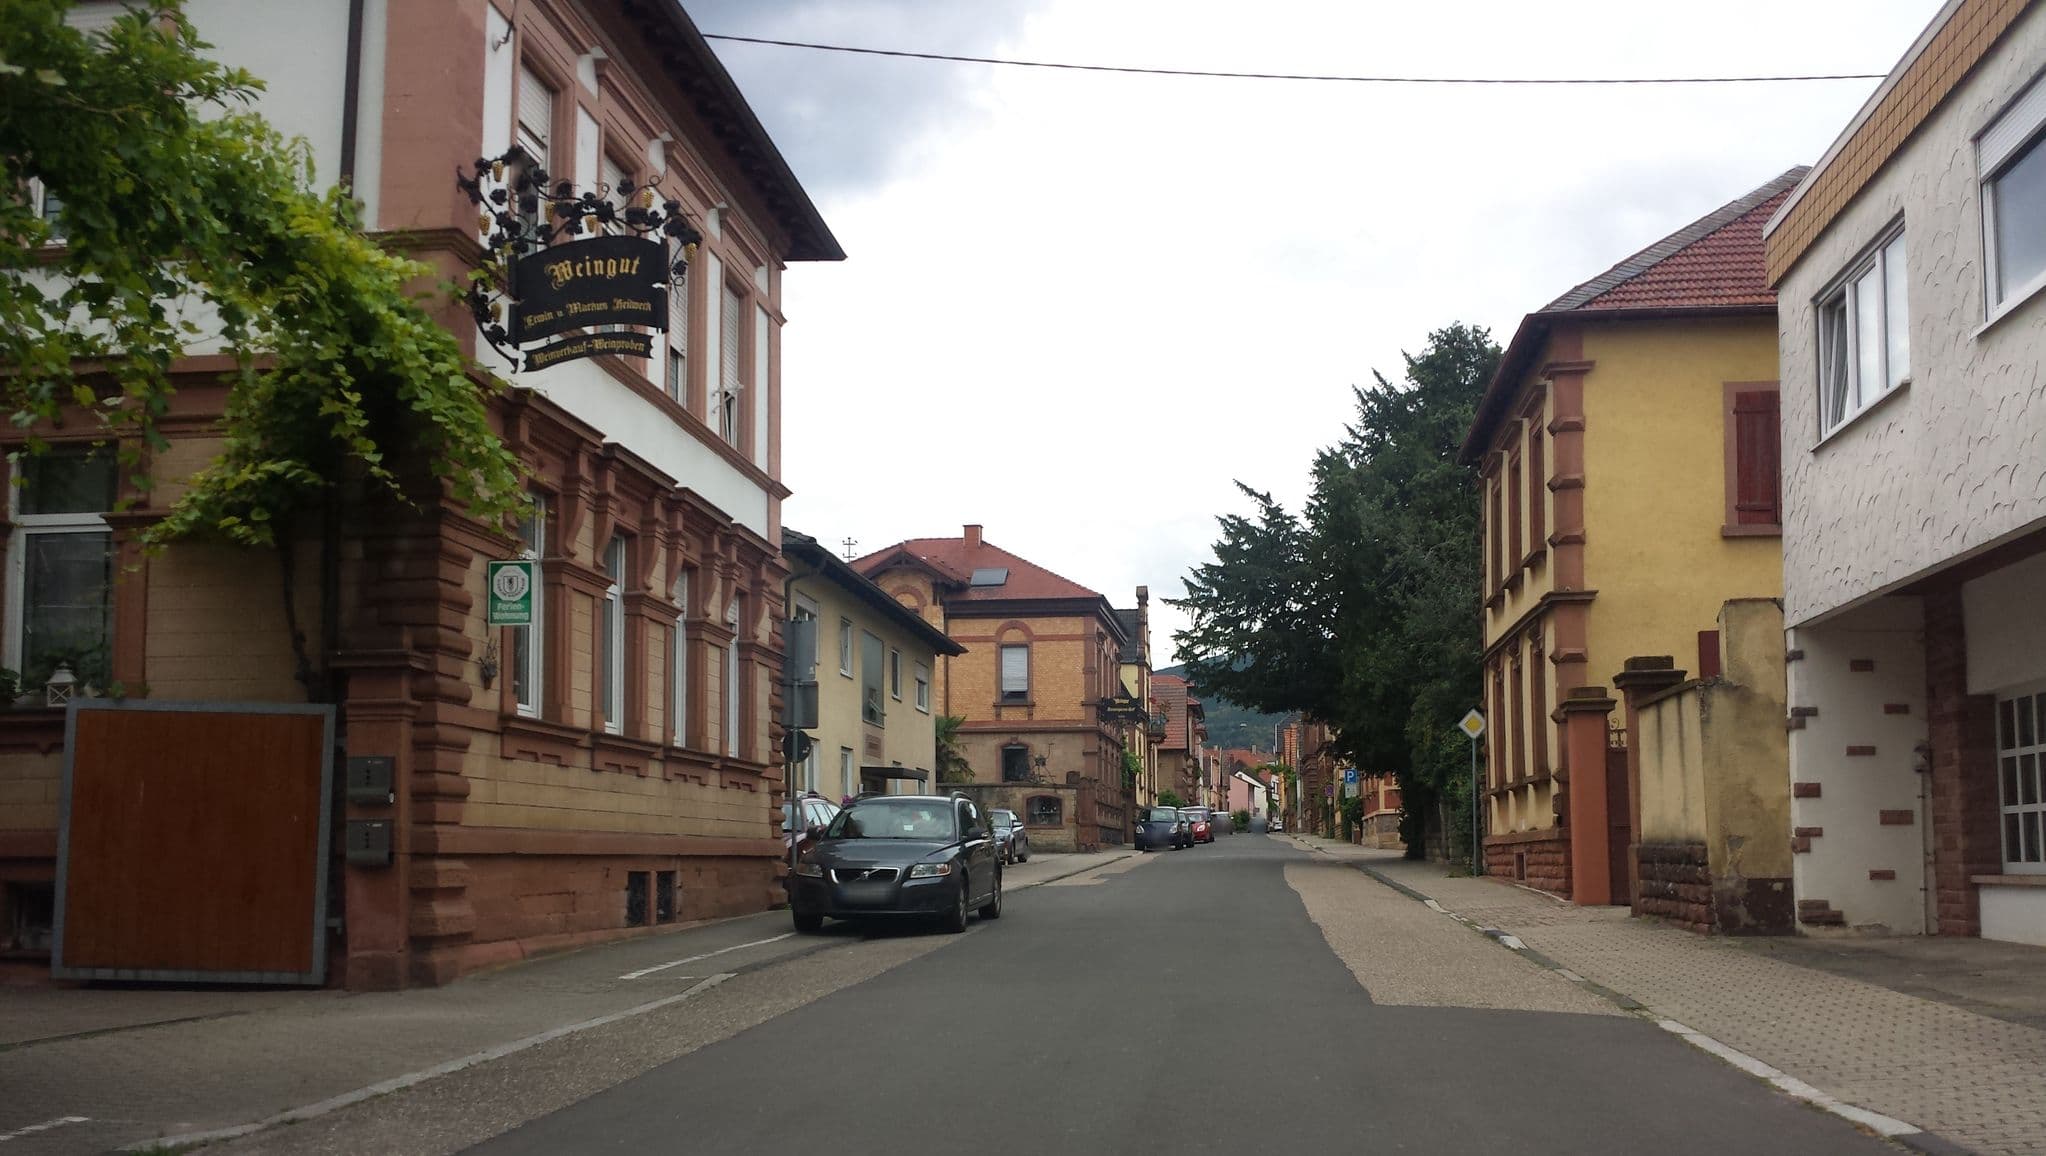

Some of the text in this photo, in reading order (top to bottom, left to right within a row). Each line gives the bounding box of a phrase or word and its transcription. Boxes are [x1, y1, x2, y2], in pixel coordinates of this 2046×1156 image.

[544, 256, 640, 290] Weingut
[524, 311, 554, 329] Erwin
[1347, 771, 1354, 781] P
